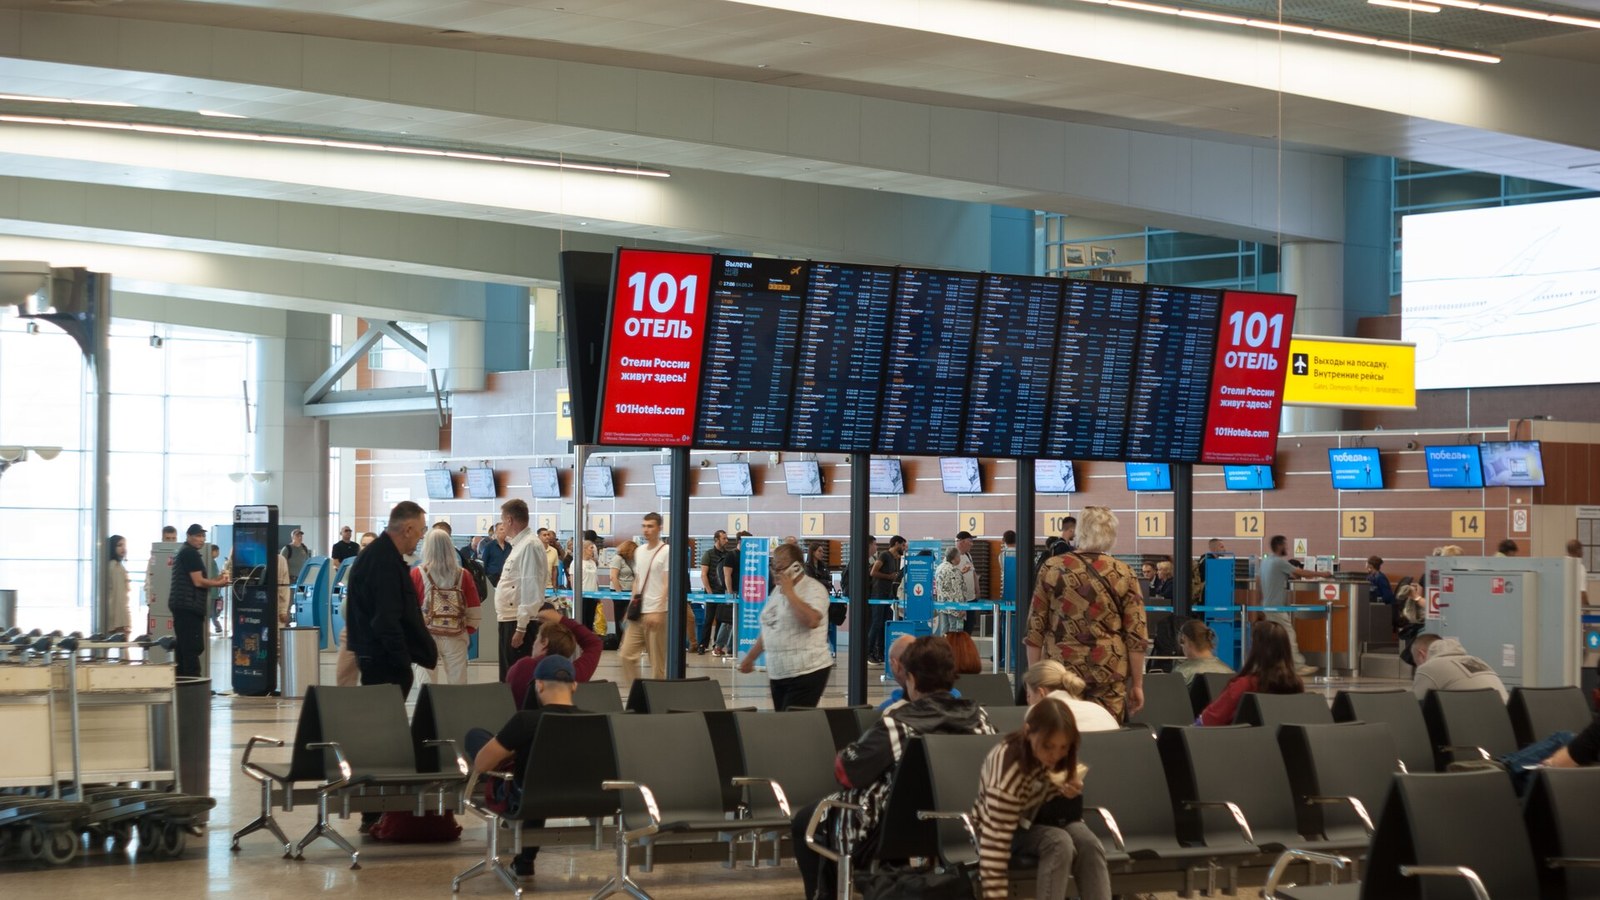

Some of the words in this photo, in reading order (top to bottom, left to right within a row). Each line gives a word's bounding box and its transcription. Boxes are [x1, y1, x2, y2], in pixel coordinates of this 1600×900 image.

[725, 260, 752, 268] Вылеты
[628, 272, 698, 314] 101
[624, 317, 693, 339] ОТЕЛЬ
[1229, 310, 1284, 349] 101
[620, 356, 652, 368] Отели
[654, 358, 690, 369] России
[1224, 351, 1278, 371] ОТЕЛЬ
[1313, 356, 1345, 367] Выходы
[1357, 360, 1389, 370] посадку.
[621, 372, 653, 383] живут
[654, 372, 687, 383] здесь!
[1313, 369, 1359, 380] Внутренние
[1360, 371, 1384, 381] рейсы
[1220, 385, 1246, 396] Отели
[1246, 387, 1275, 397] России
[615, 404, 685, 415] 101Hotels.com
[1220, 399, 1245, 409] живут
[1246, 400, 1272, 409] здесь!
[681, 434, 690, 442] 0+
[1214, 427, 1270, 438] 101Hotels.com
[1333, 452, 1364, 463] победа
[1430, 450, 1462, 460] победа
[482, 518, 487, 530] 2
[598, 518, 604, 529] 4
[735, 517, 741, 531] 6
[810, 517, 816, 531] 7
[883, 517, 890, 531] 8
[969, 516, 976, 531] 9
[1050, 517, 1063, 532] 10
[1145, 516, 1158, 532] 11
[1242, 516, 1258, 532] 12
[1350, 516, 1367, 533] 13
[1459, 515, 1478, 533] 14
